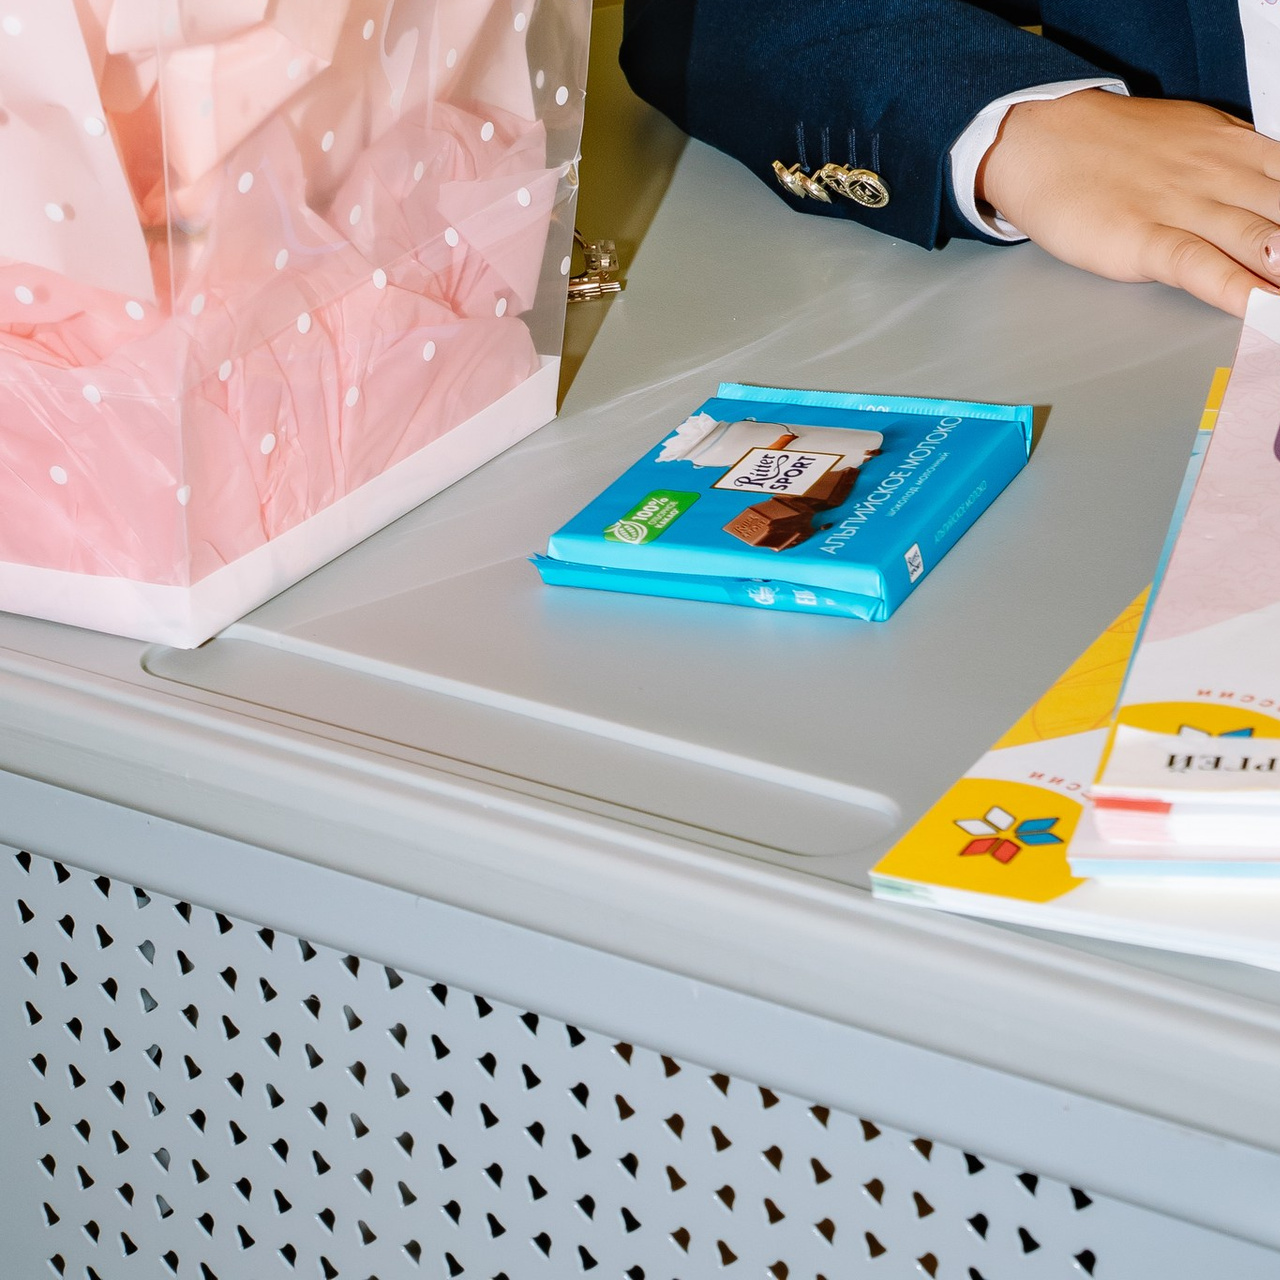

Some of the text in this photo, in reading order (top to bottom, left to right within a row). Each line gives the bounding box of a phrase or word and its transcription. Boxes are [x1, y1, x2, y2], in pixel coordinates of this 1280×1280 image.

[734, 453, 783, 489] Ritter
[769, 455, 817, 491] SPORT
[819, 470, 913, 555] АЛЬПИЙСКОЕ
[903, 416, 963, 471] МОЛОКО
[632, 497, 669, 521] 100%
